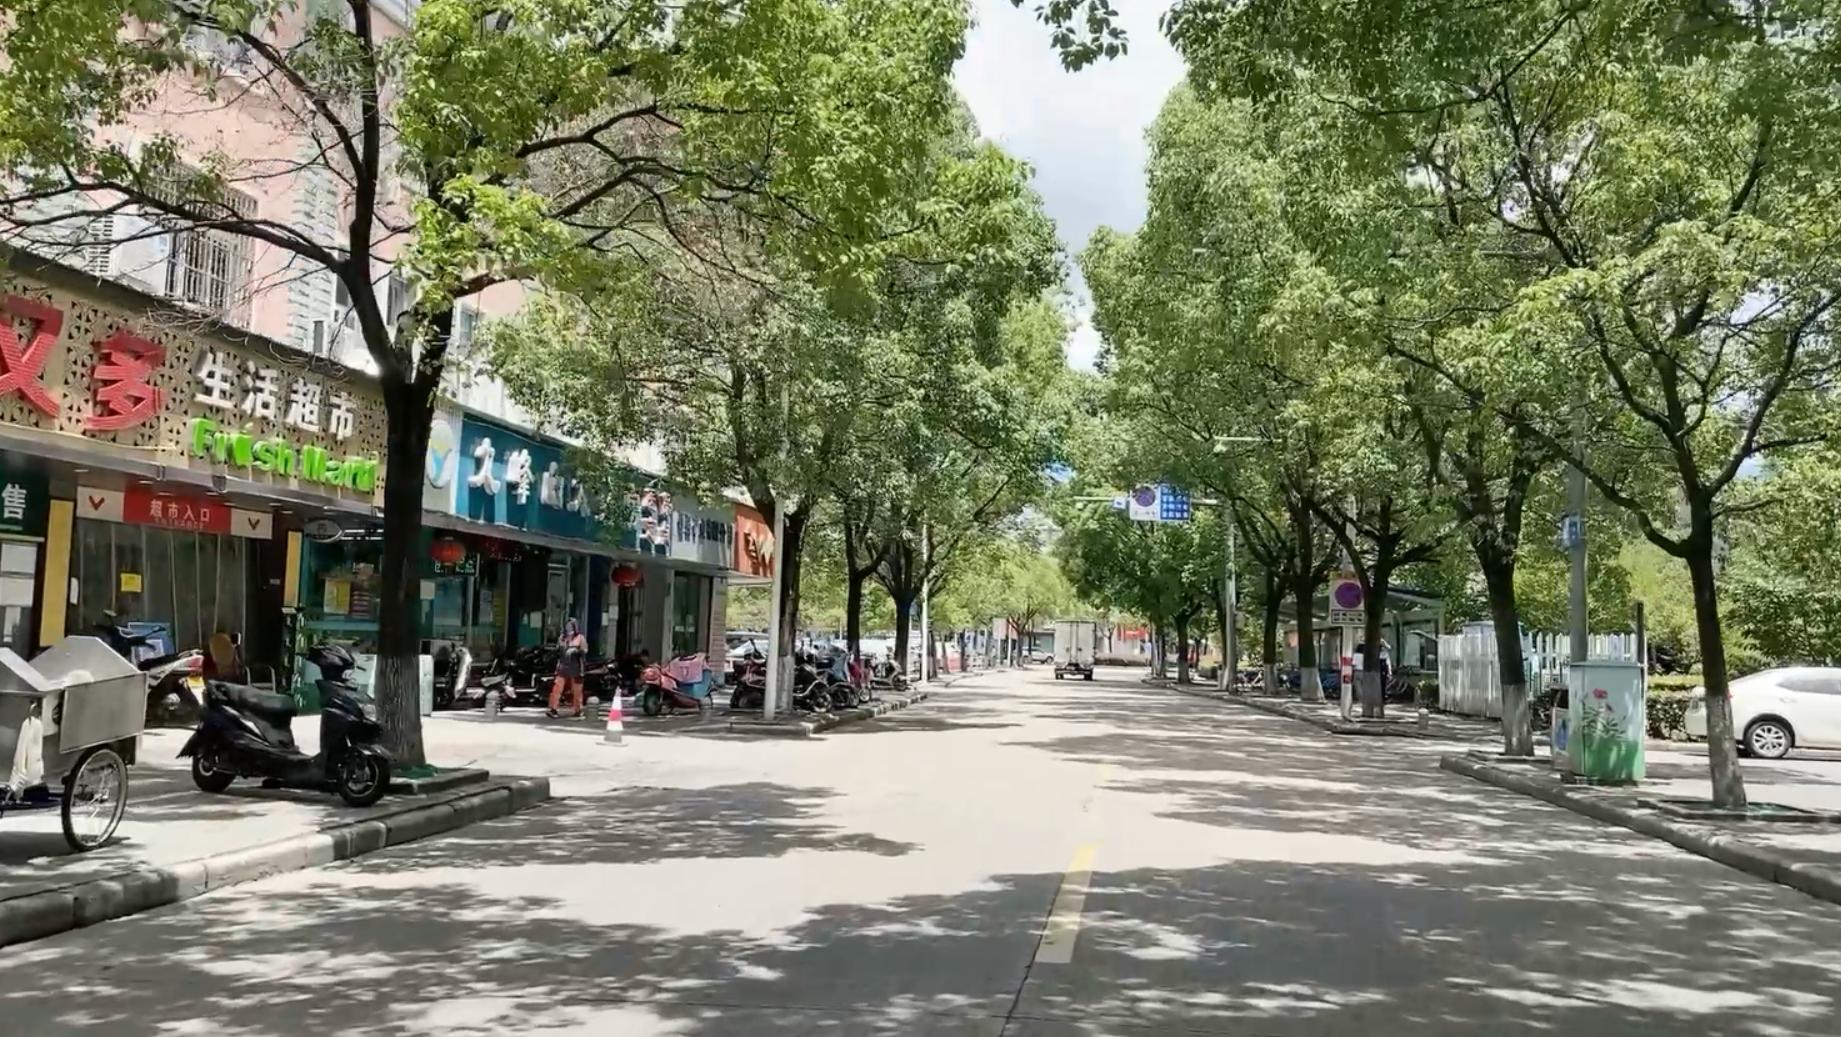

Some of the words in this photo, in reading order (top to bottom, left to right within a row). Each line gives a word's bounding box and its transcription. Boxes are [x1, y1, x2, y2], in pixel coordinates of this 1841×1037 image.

[193, 350, 357, 441] 生活超市
[150, 499, 210, 522] 超市入口
